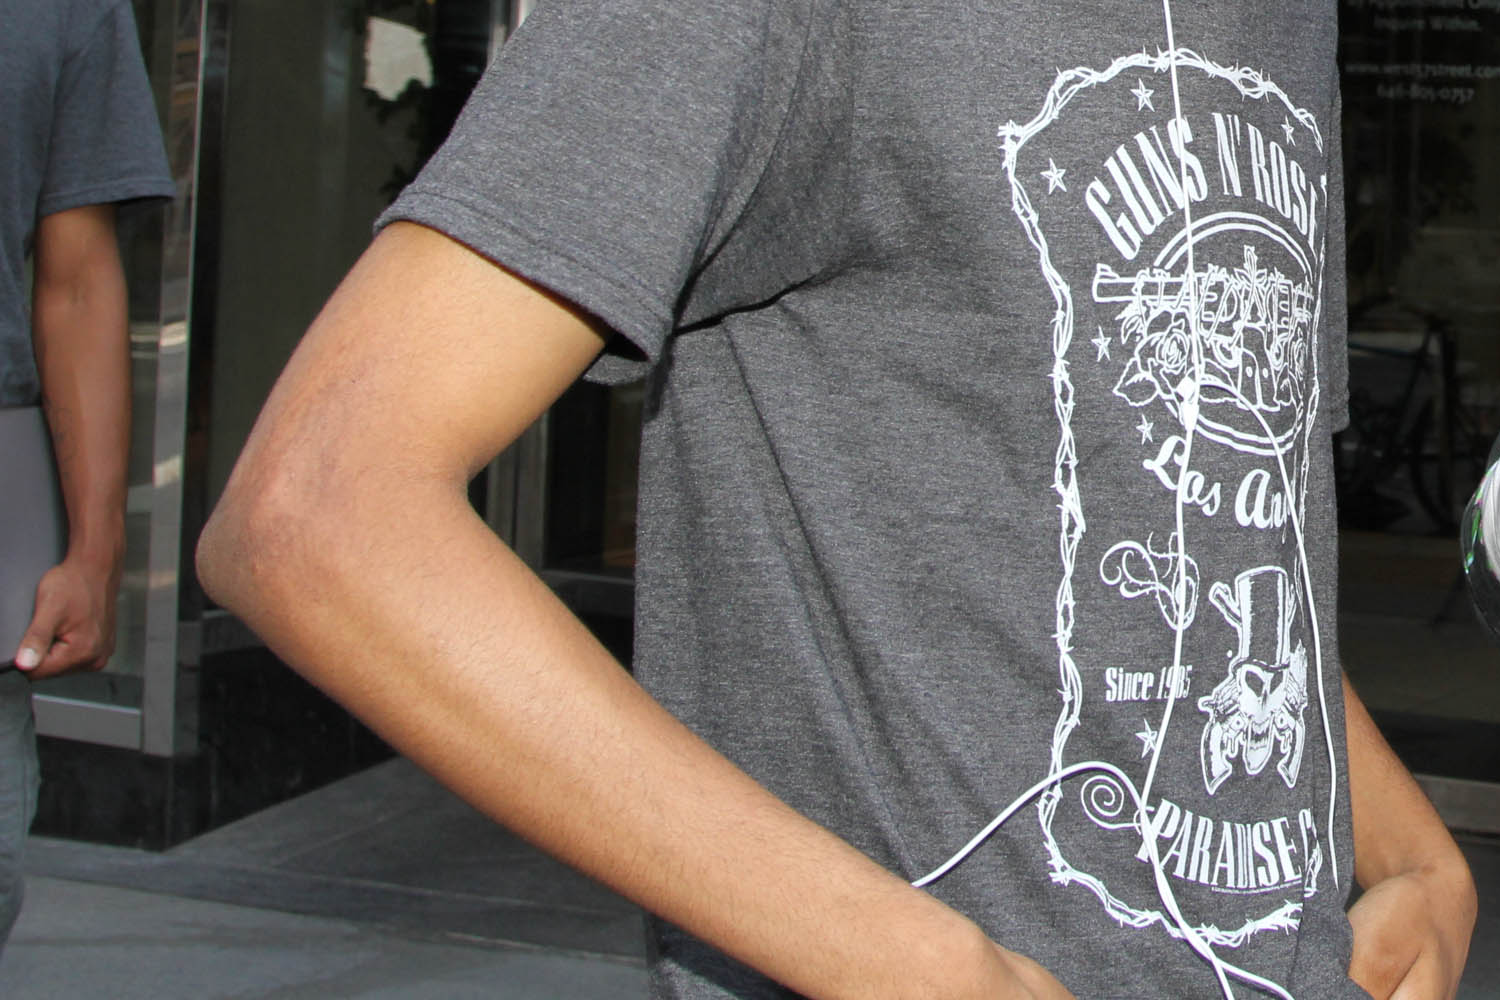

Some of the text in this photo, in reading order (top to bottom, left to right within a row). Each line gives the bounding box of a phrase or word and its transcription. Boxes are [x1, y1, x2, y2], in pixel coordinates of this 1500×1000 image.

[1084, 117, 1209, 261] GUNS
[1142, 434, 1222, 518] Los
[1105, 666, 1155, 702] Since
